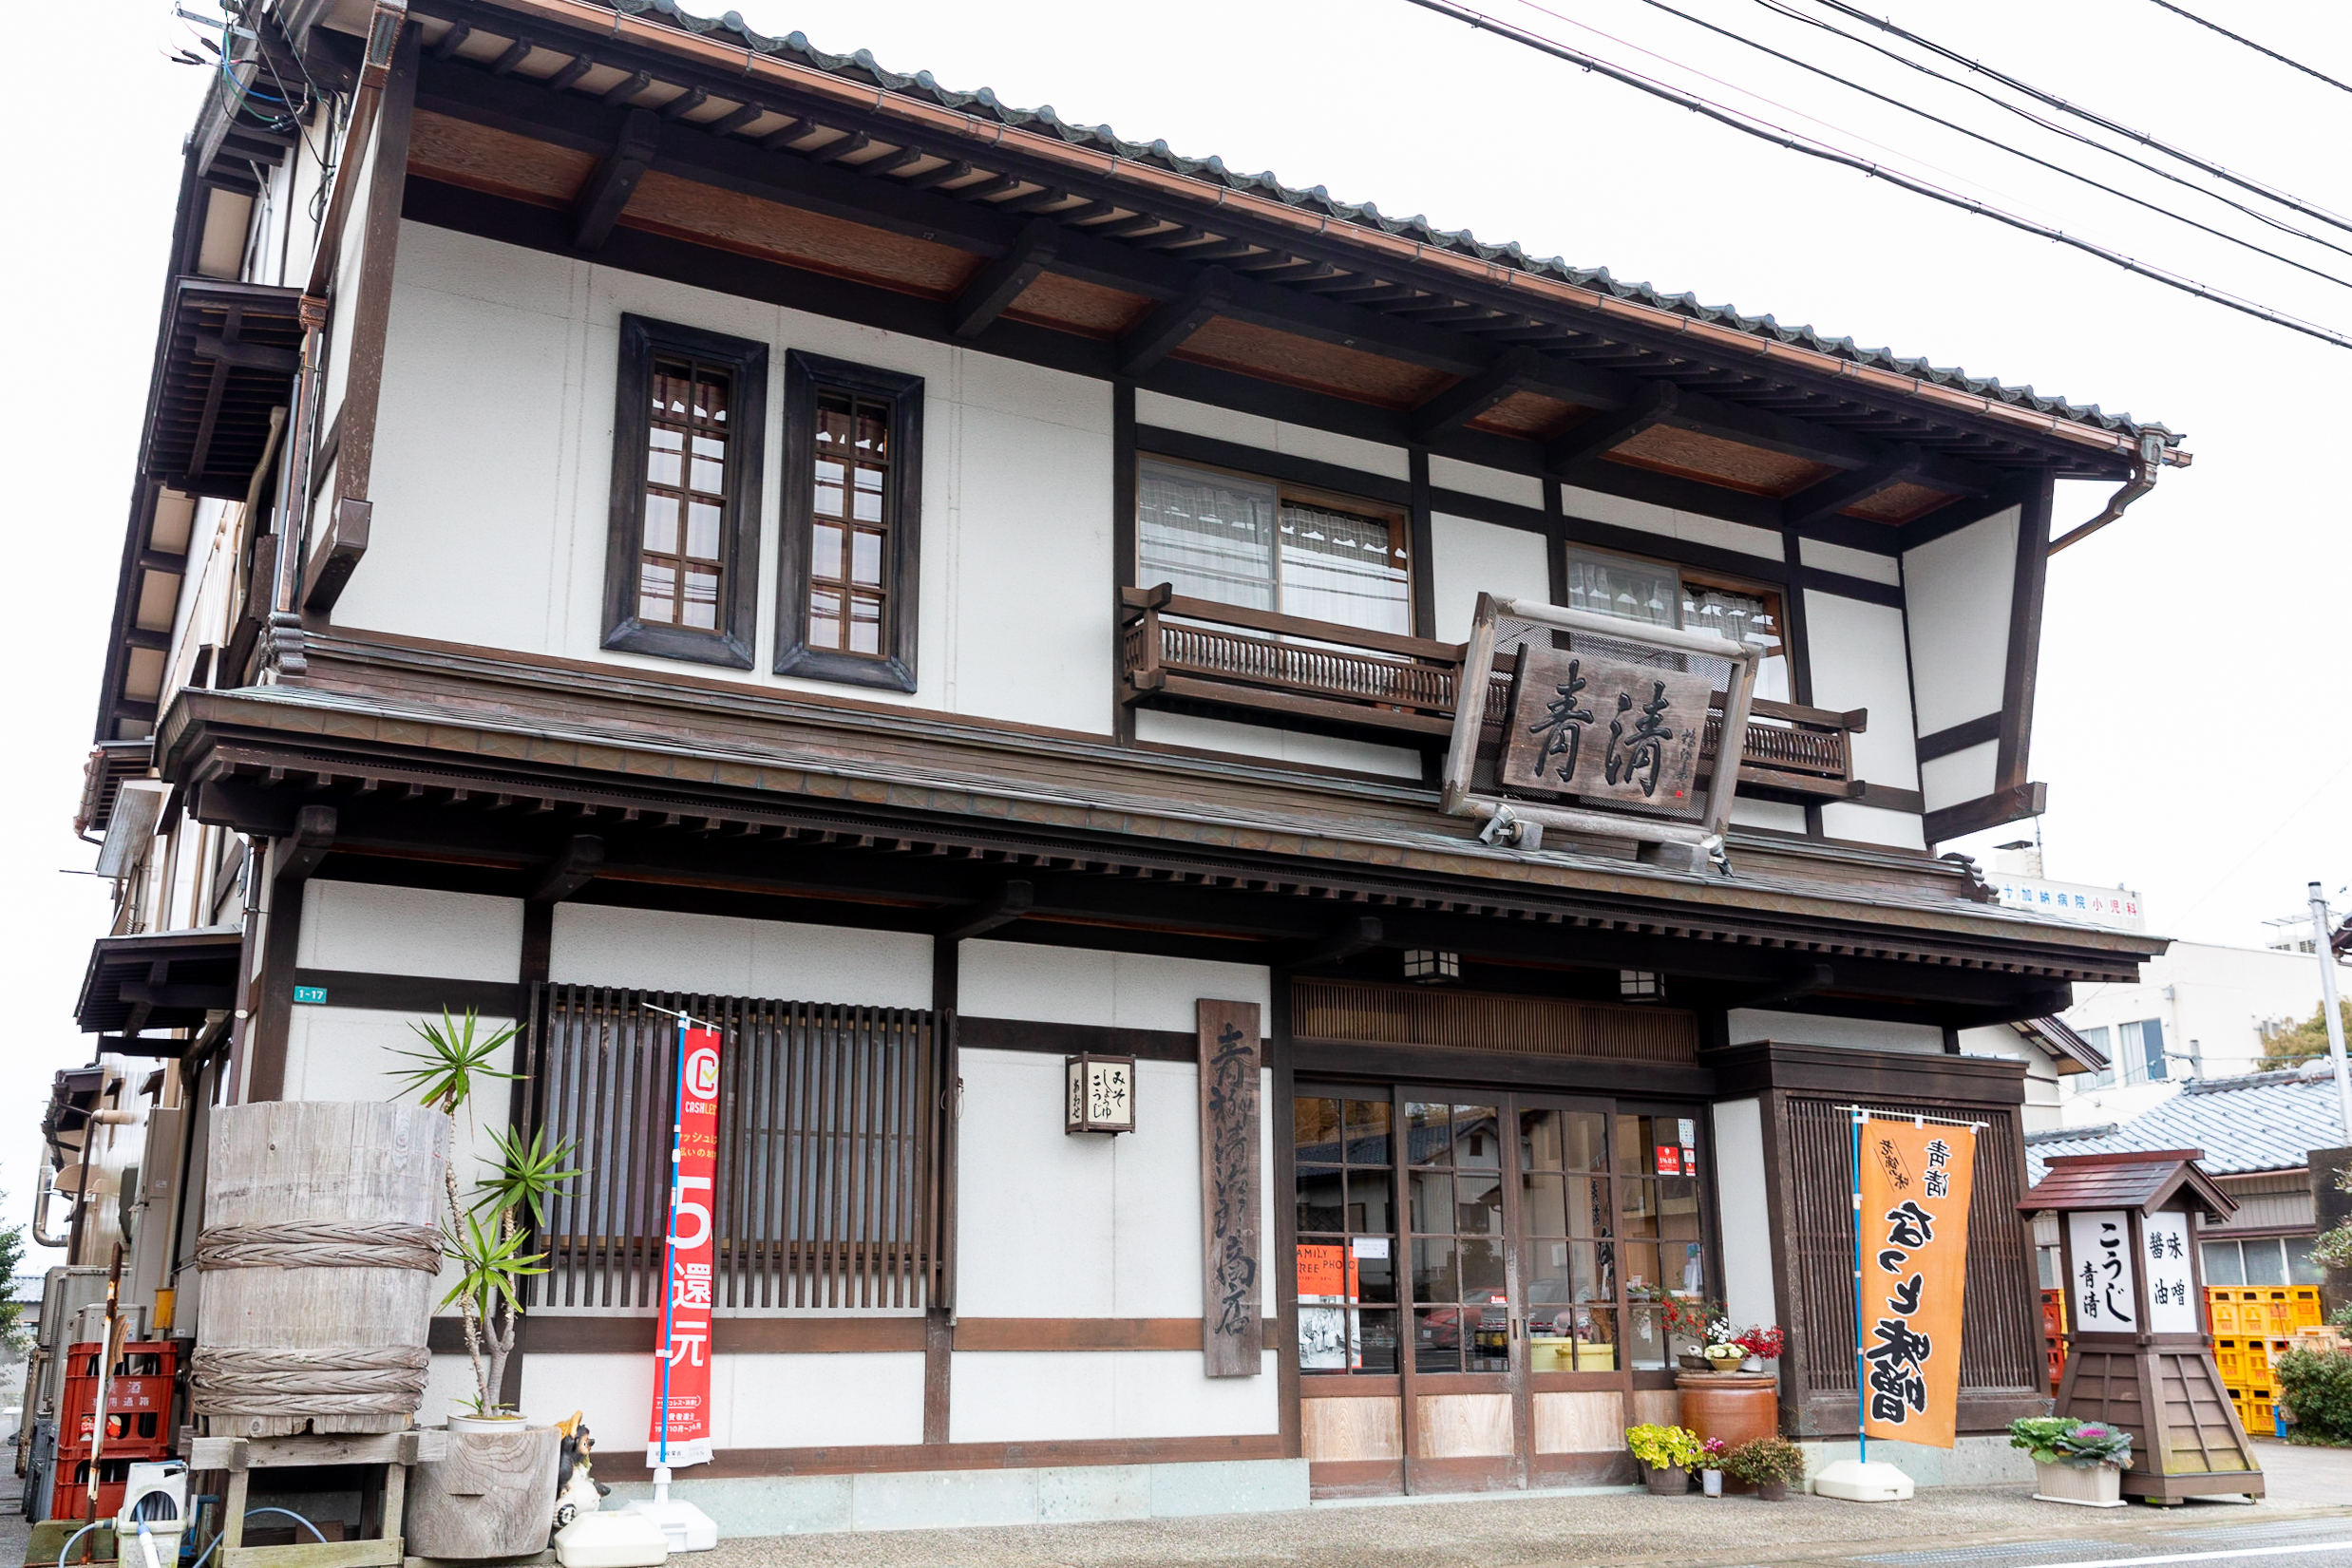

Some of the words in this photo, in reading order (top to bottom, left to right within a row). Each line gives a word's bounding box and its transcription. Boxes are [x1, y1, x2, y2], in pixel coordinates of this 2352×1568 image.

[299, 989, 324, 1000] 1-17
[1092, 1074, 1102, 1119] こうじ
[1111, 1070, 1126, 1108] みそ
[1297, 1247, 1328, 1259] AMILY
[1298, 1262, 1319, 1274] REE
[1323, 1259, 1356, 1270] PHOO
[2078, 1260, 2100, 1319] 青清
[2099, 1222, 2133, 1323] こうじ
